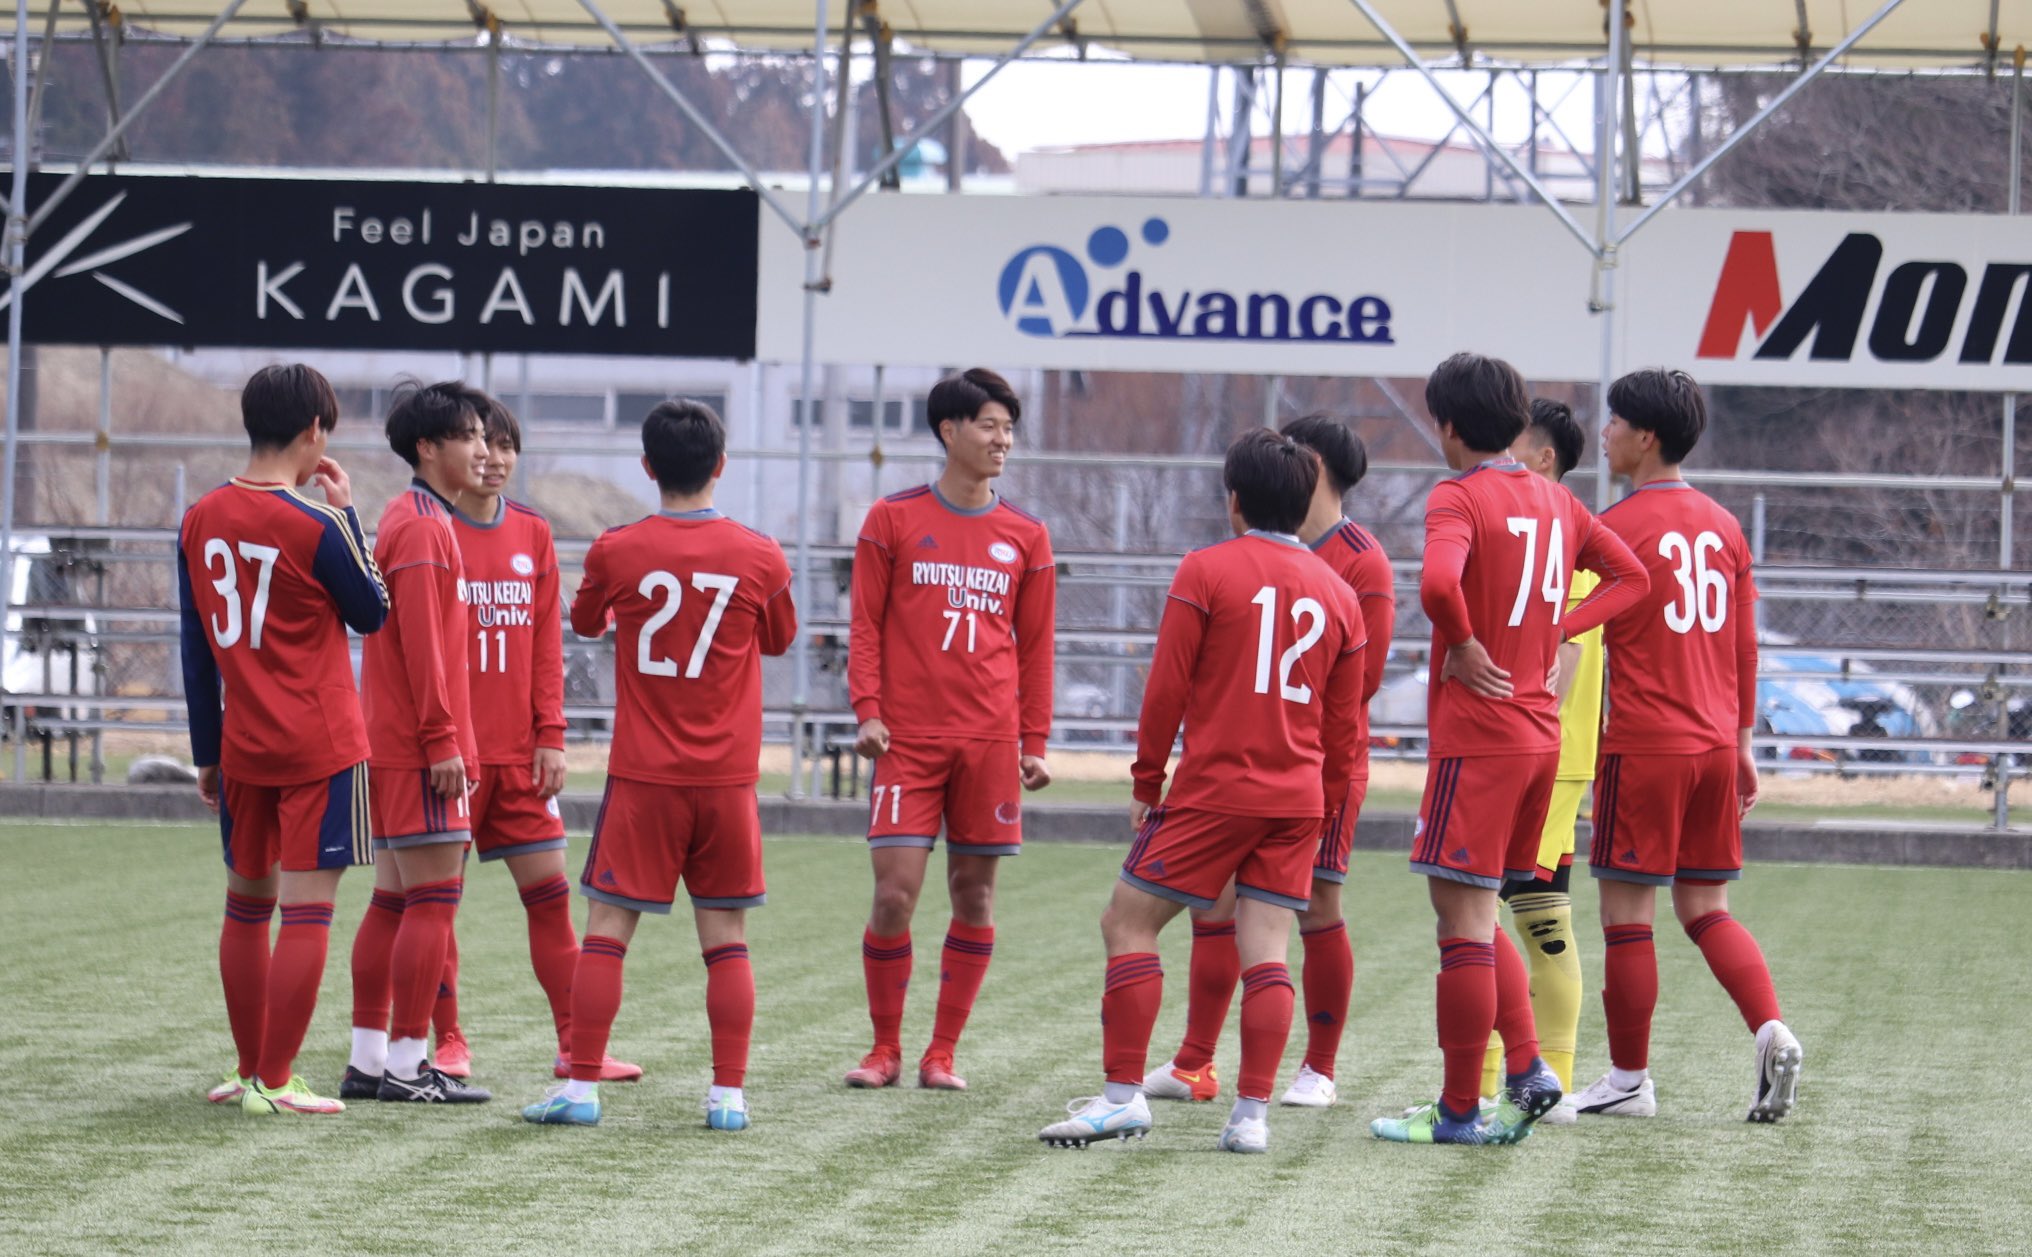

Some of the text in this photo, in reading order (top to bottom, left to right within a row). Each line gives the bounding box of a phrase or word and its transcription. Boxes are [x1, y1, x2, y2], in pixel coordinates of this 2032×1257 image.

[333, 206, 605, 256] Feel Japan
[256, 262, 670, 327] KAGAMI
[997, 232, 1395, 345] Advance
[204, 538, 280, 649] 37
[494, 581, 532, 605] KEIZAI
[912, 561, 1011, 597] RYUTSU KEIZAI
[1505, 516, 1566, 628] 74
[1657, 530, 1729, 634] 36
[478, 604, 532, 628] Univ.
[637, 570, 740, 680] 27
[948, 587, 1004, 616] Univ.
[477, 630, 506, 673] 11
[941, 609, 977, 653] 71
[1250, 585, 1327, 706] 12
[871, 784, 902, 827] 71
